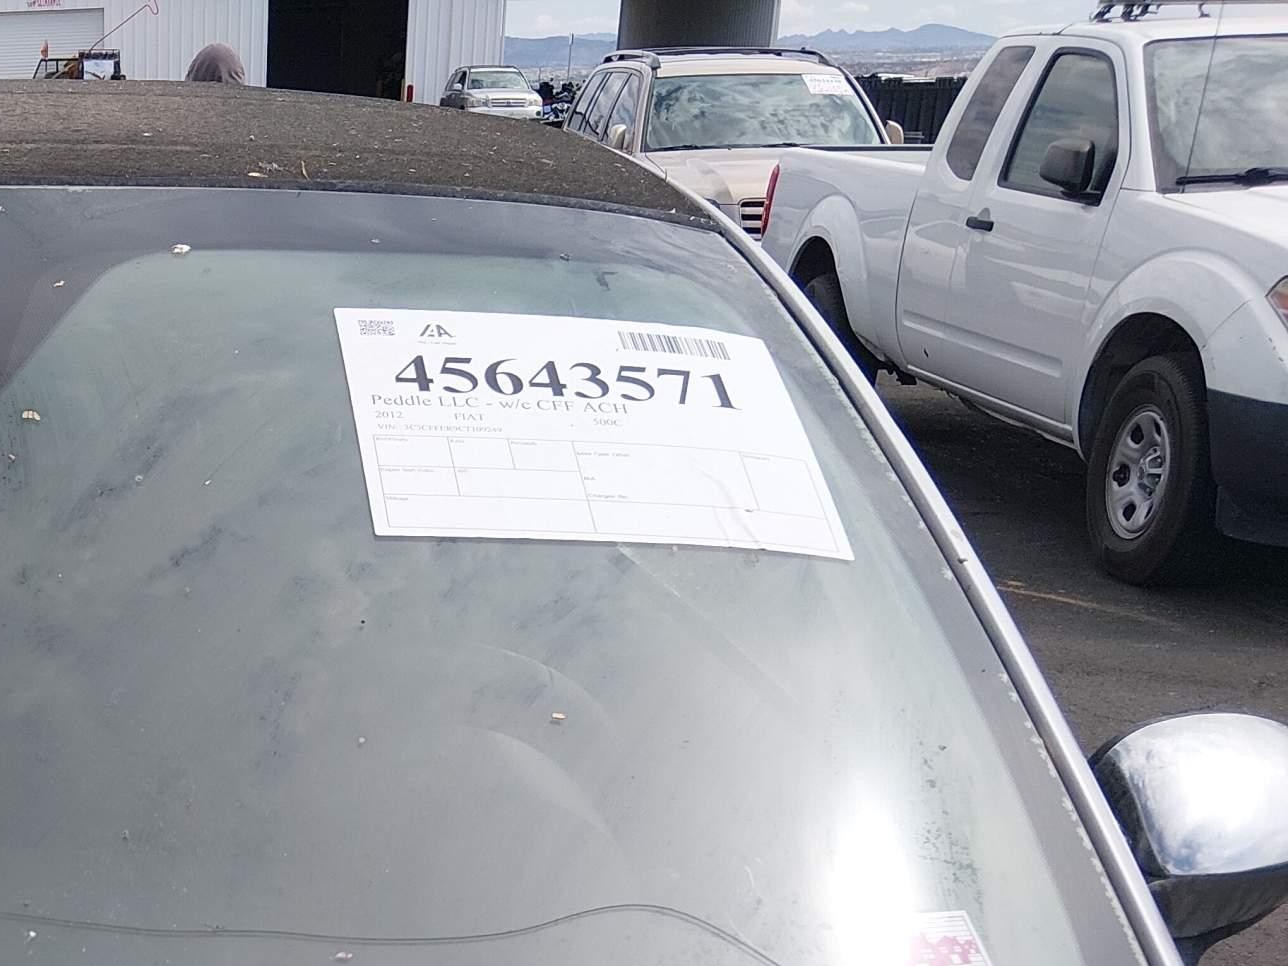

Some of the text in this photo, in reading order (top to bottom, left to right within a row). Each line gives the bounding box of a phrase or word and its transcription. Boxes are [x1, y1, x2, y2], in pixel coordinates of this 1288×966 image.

[395, 354, 743, 411] 45643571
[371, 393, 432, 407] Peddle
[438, 395, 481, 408] LLC
[583, 401, 628, 415] ACH
[375, 410, 623, 427] 2012 FIAT 500C
